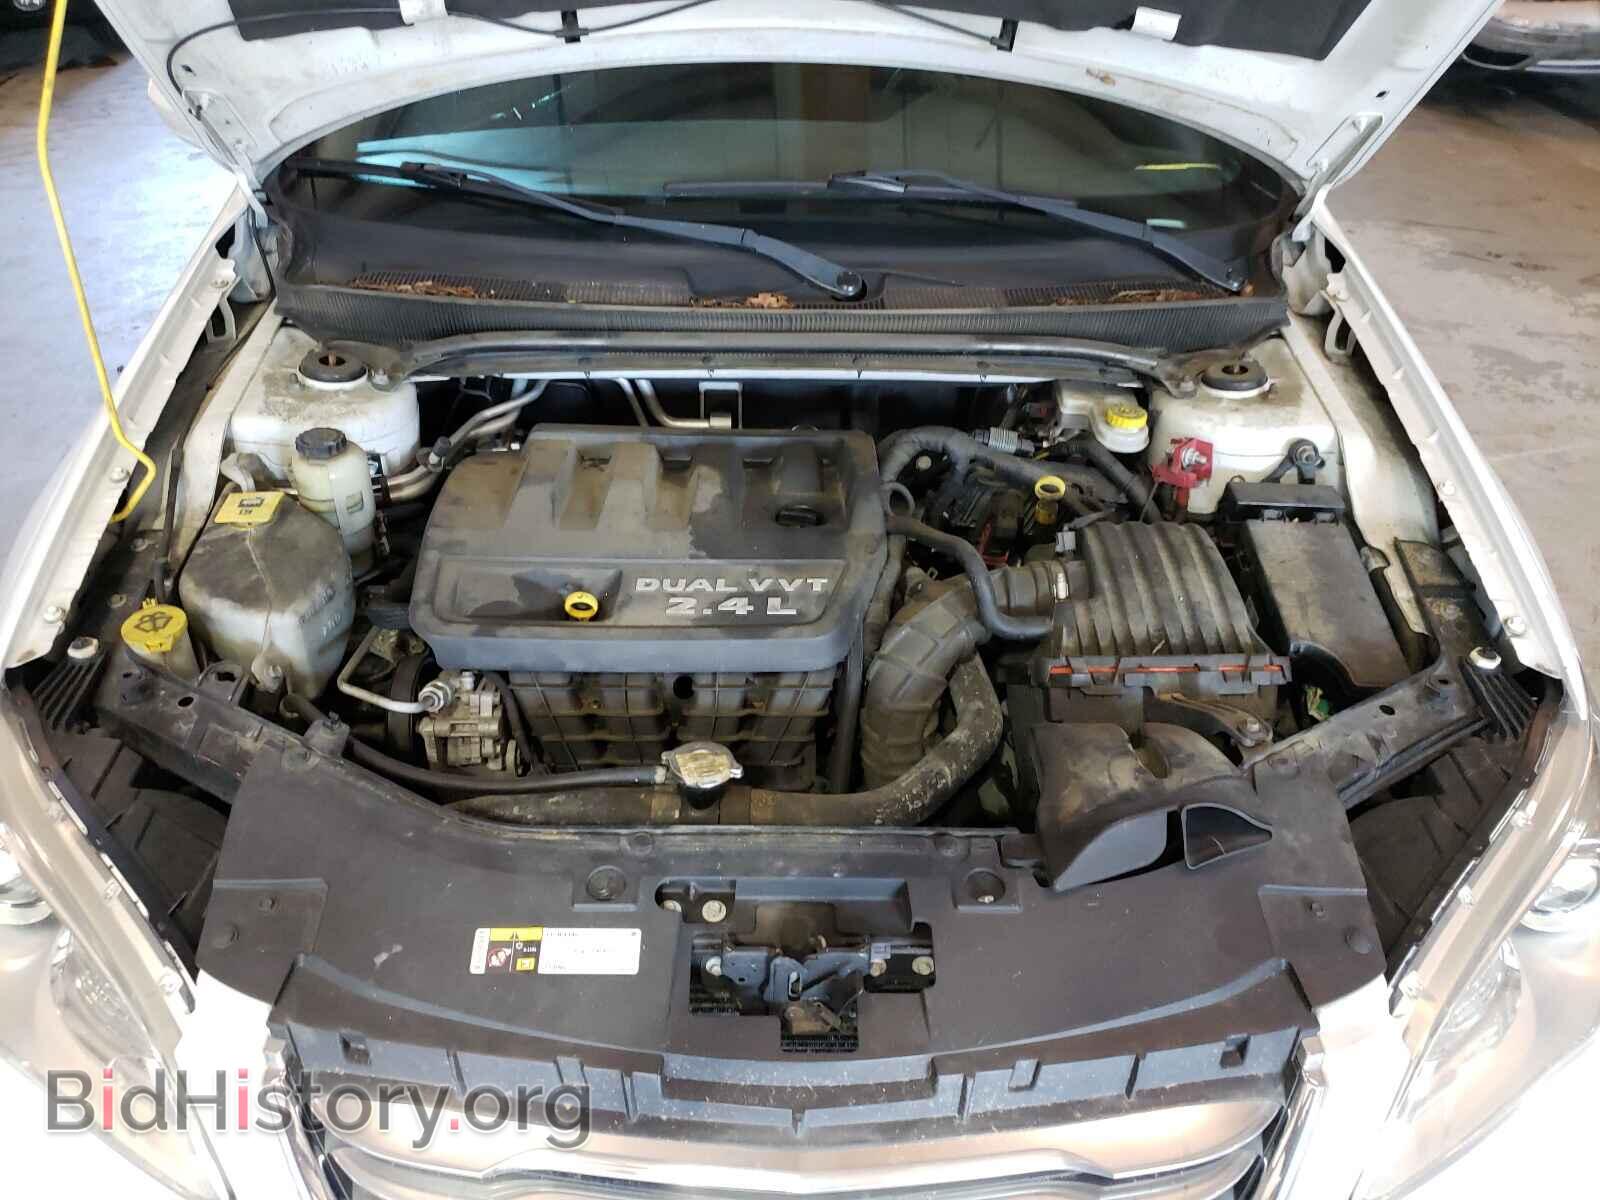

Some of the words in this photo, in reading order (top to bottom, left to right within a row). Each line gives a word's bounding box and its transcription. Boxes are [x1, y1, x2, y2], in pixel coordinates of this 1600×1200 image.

[635, 577, 738, 592] DUAL
[749, 577, 829, 592] VVT
[665, 597, 754, 615] 2.4
[767, 597, 797, 615] L
